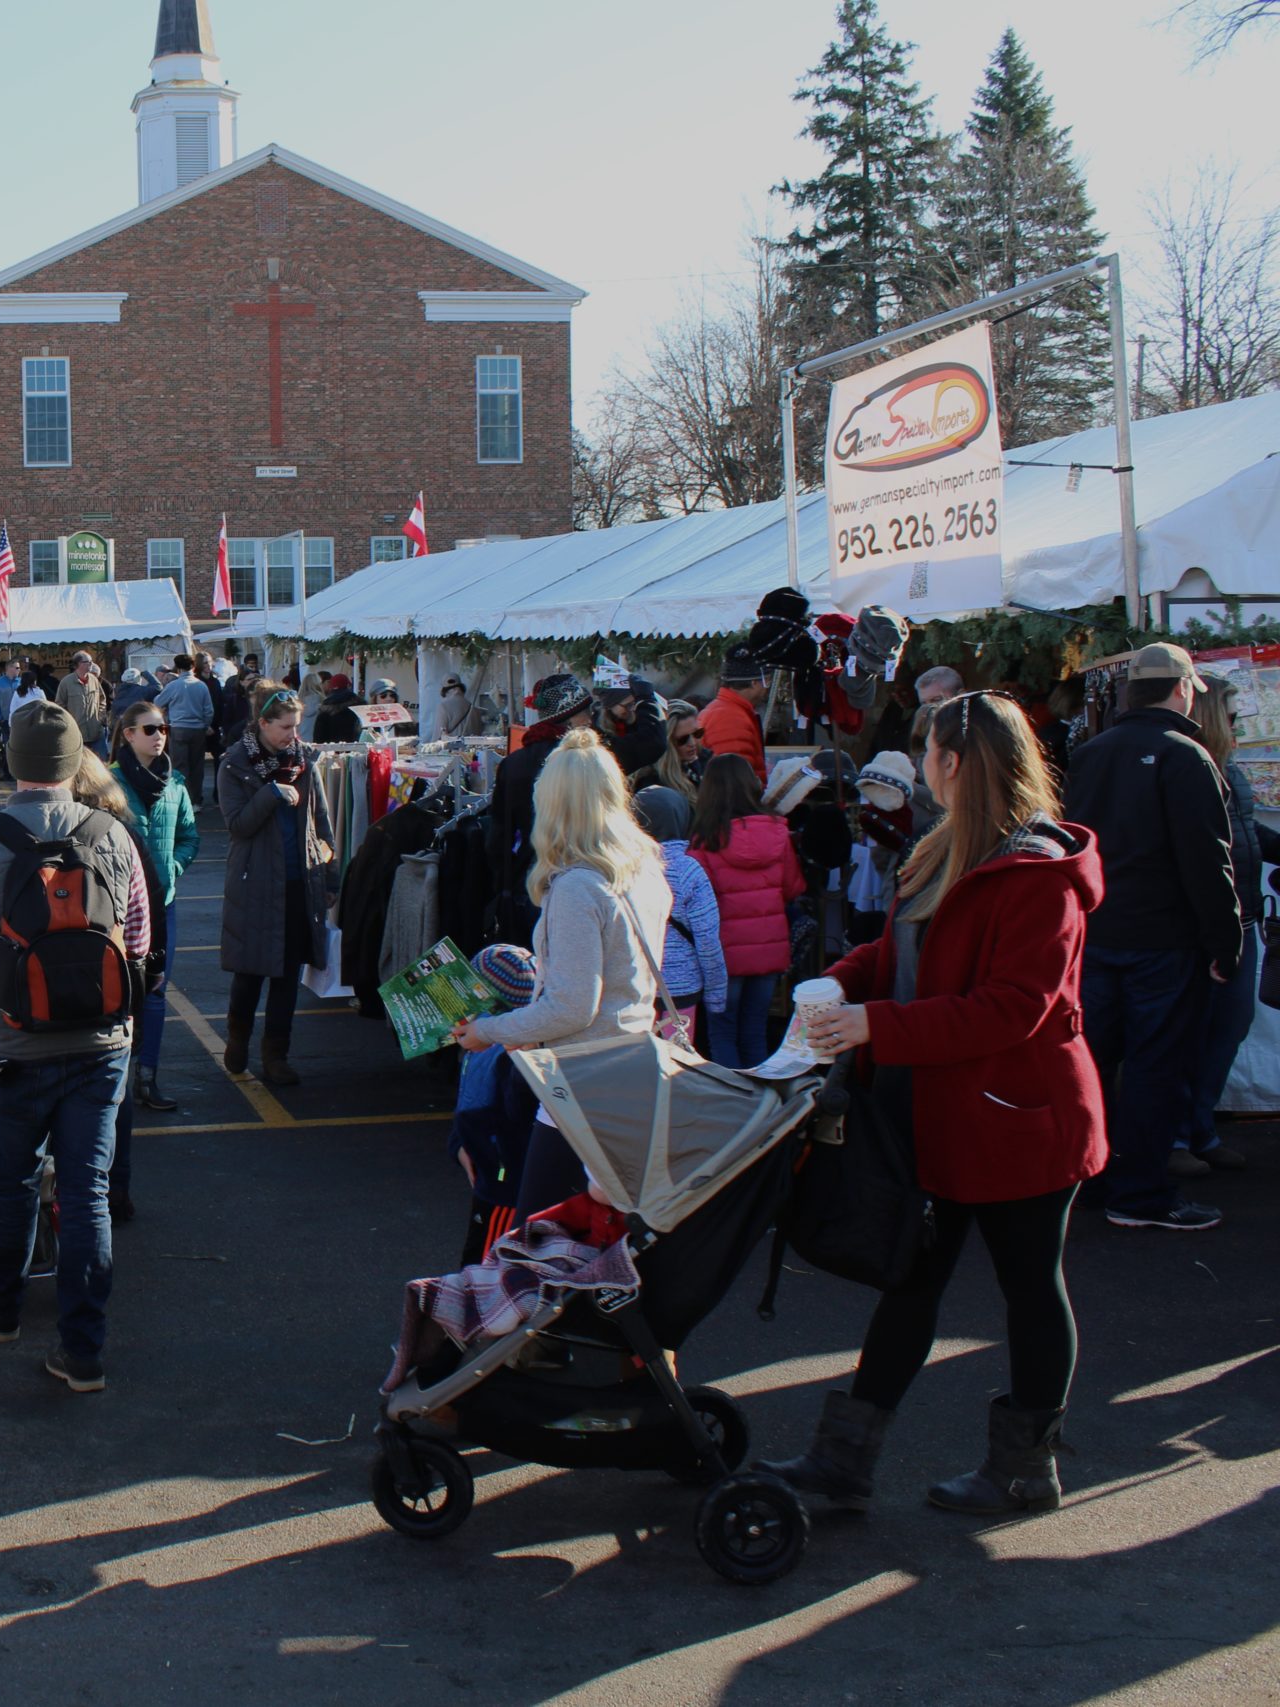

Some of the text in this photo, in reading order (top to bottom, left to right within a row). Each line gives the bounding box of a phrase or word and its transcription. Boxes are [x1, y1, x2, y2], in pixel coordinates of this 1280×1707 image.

[834, 428, 882, 461] German
[833, 466, 1001, 515] www.germanspecialtyimport.com
[838, 498, 997, 563] 952.226.2563
[68, 550, 107, 561] minnetonka
